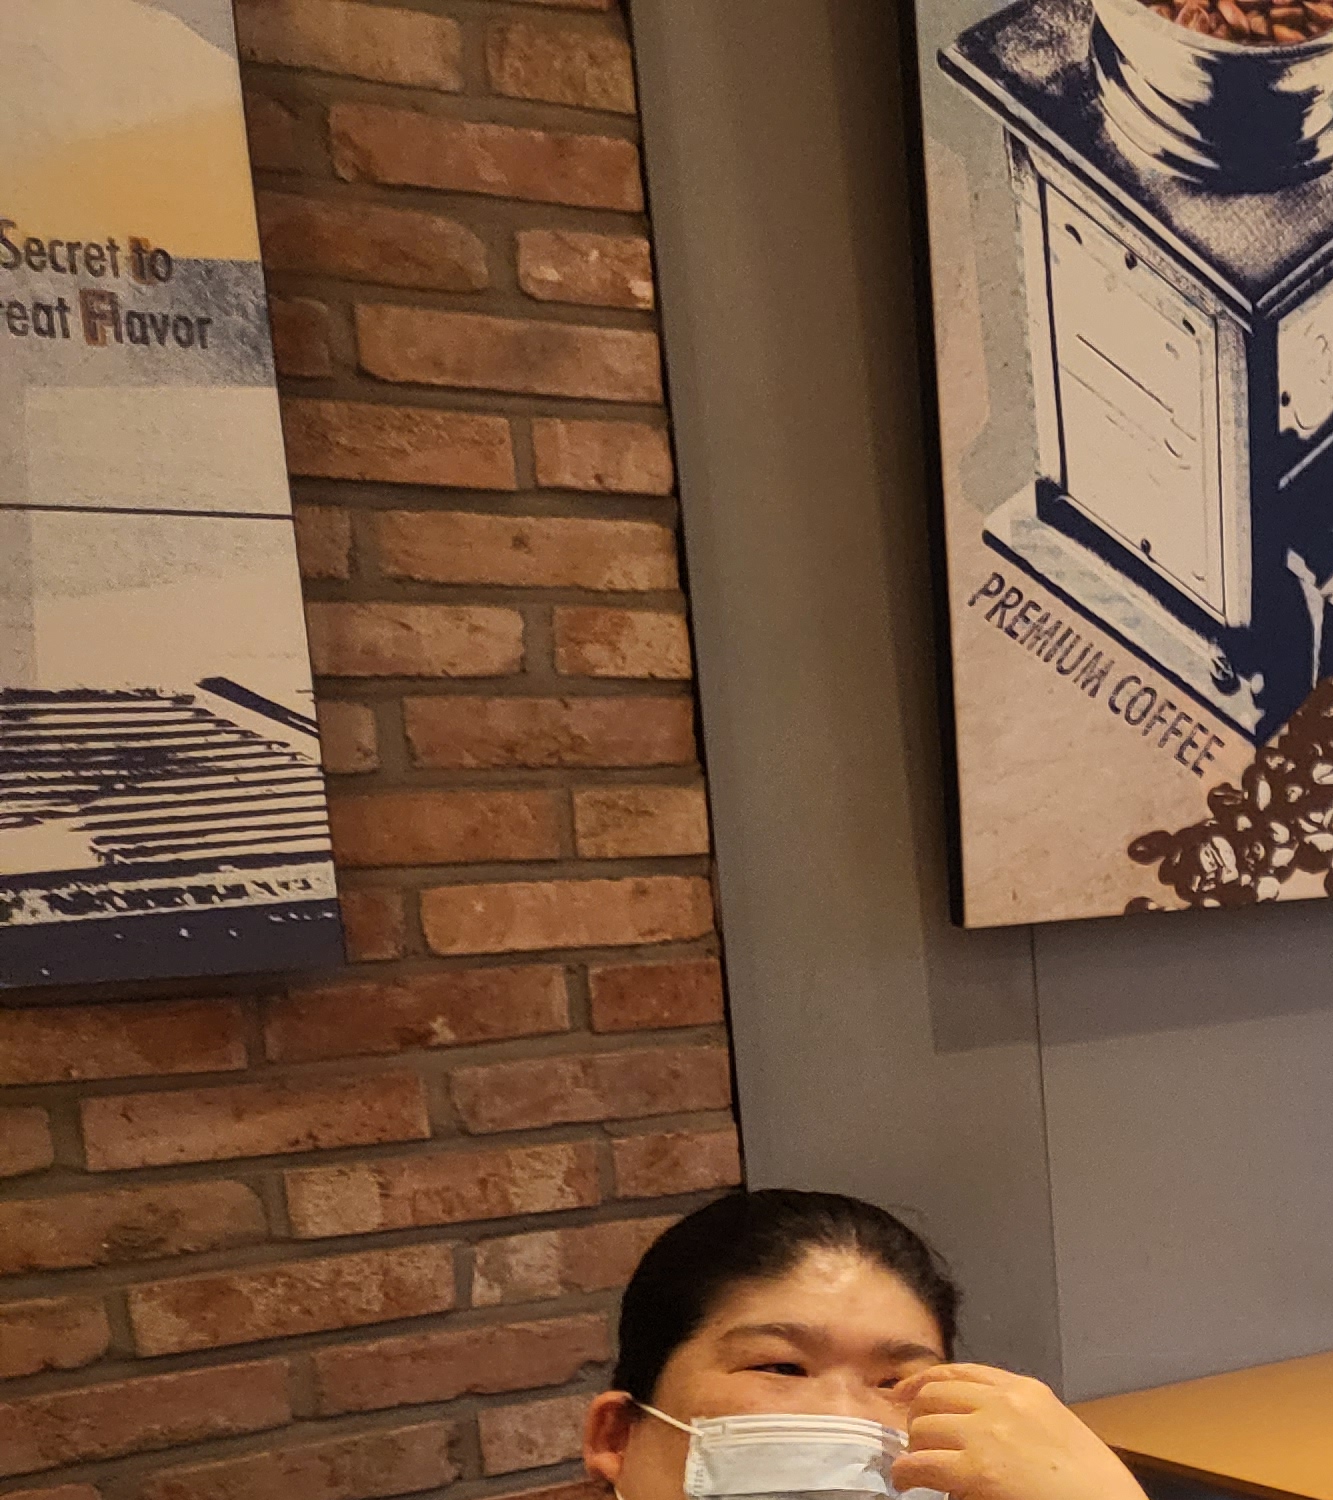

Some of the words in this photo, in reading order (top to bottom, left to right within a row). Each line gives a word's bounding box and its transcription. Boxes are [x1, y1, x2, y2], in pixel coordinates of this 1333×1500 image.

[0, 219, 120, 278] Secret
[128, 237, 172, 284] to
[0, 297, 70, 339] eat
[79, 288, 213, 350] Flavor
[967, 572, 1115, 698] PREMIUM
[1108, 675, 1225, 778] COFFEE
